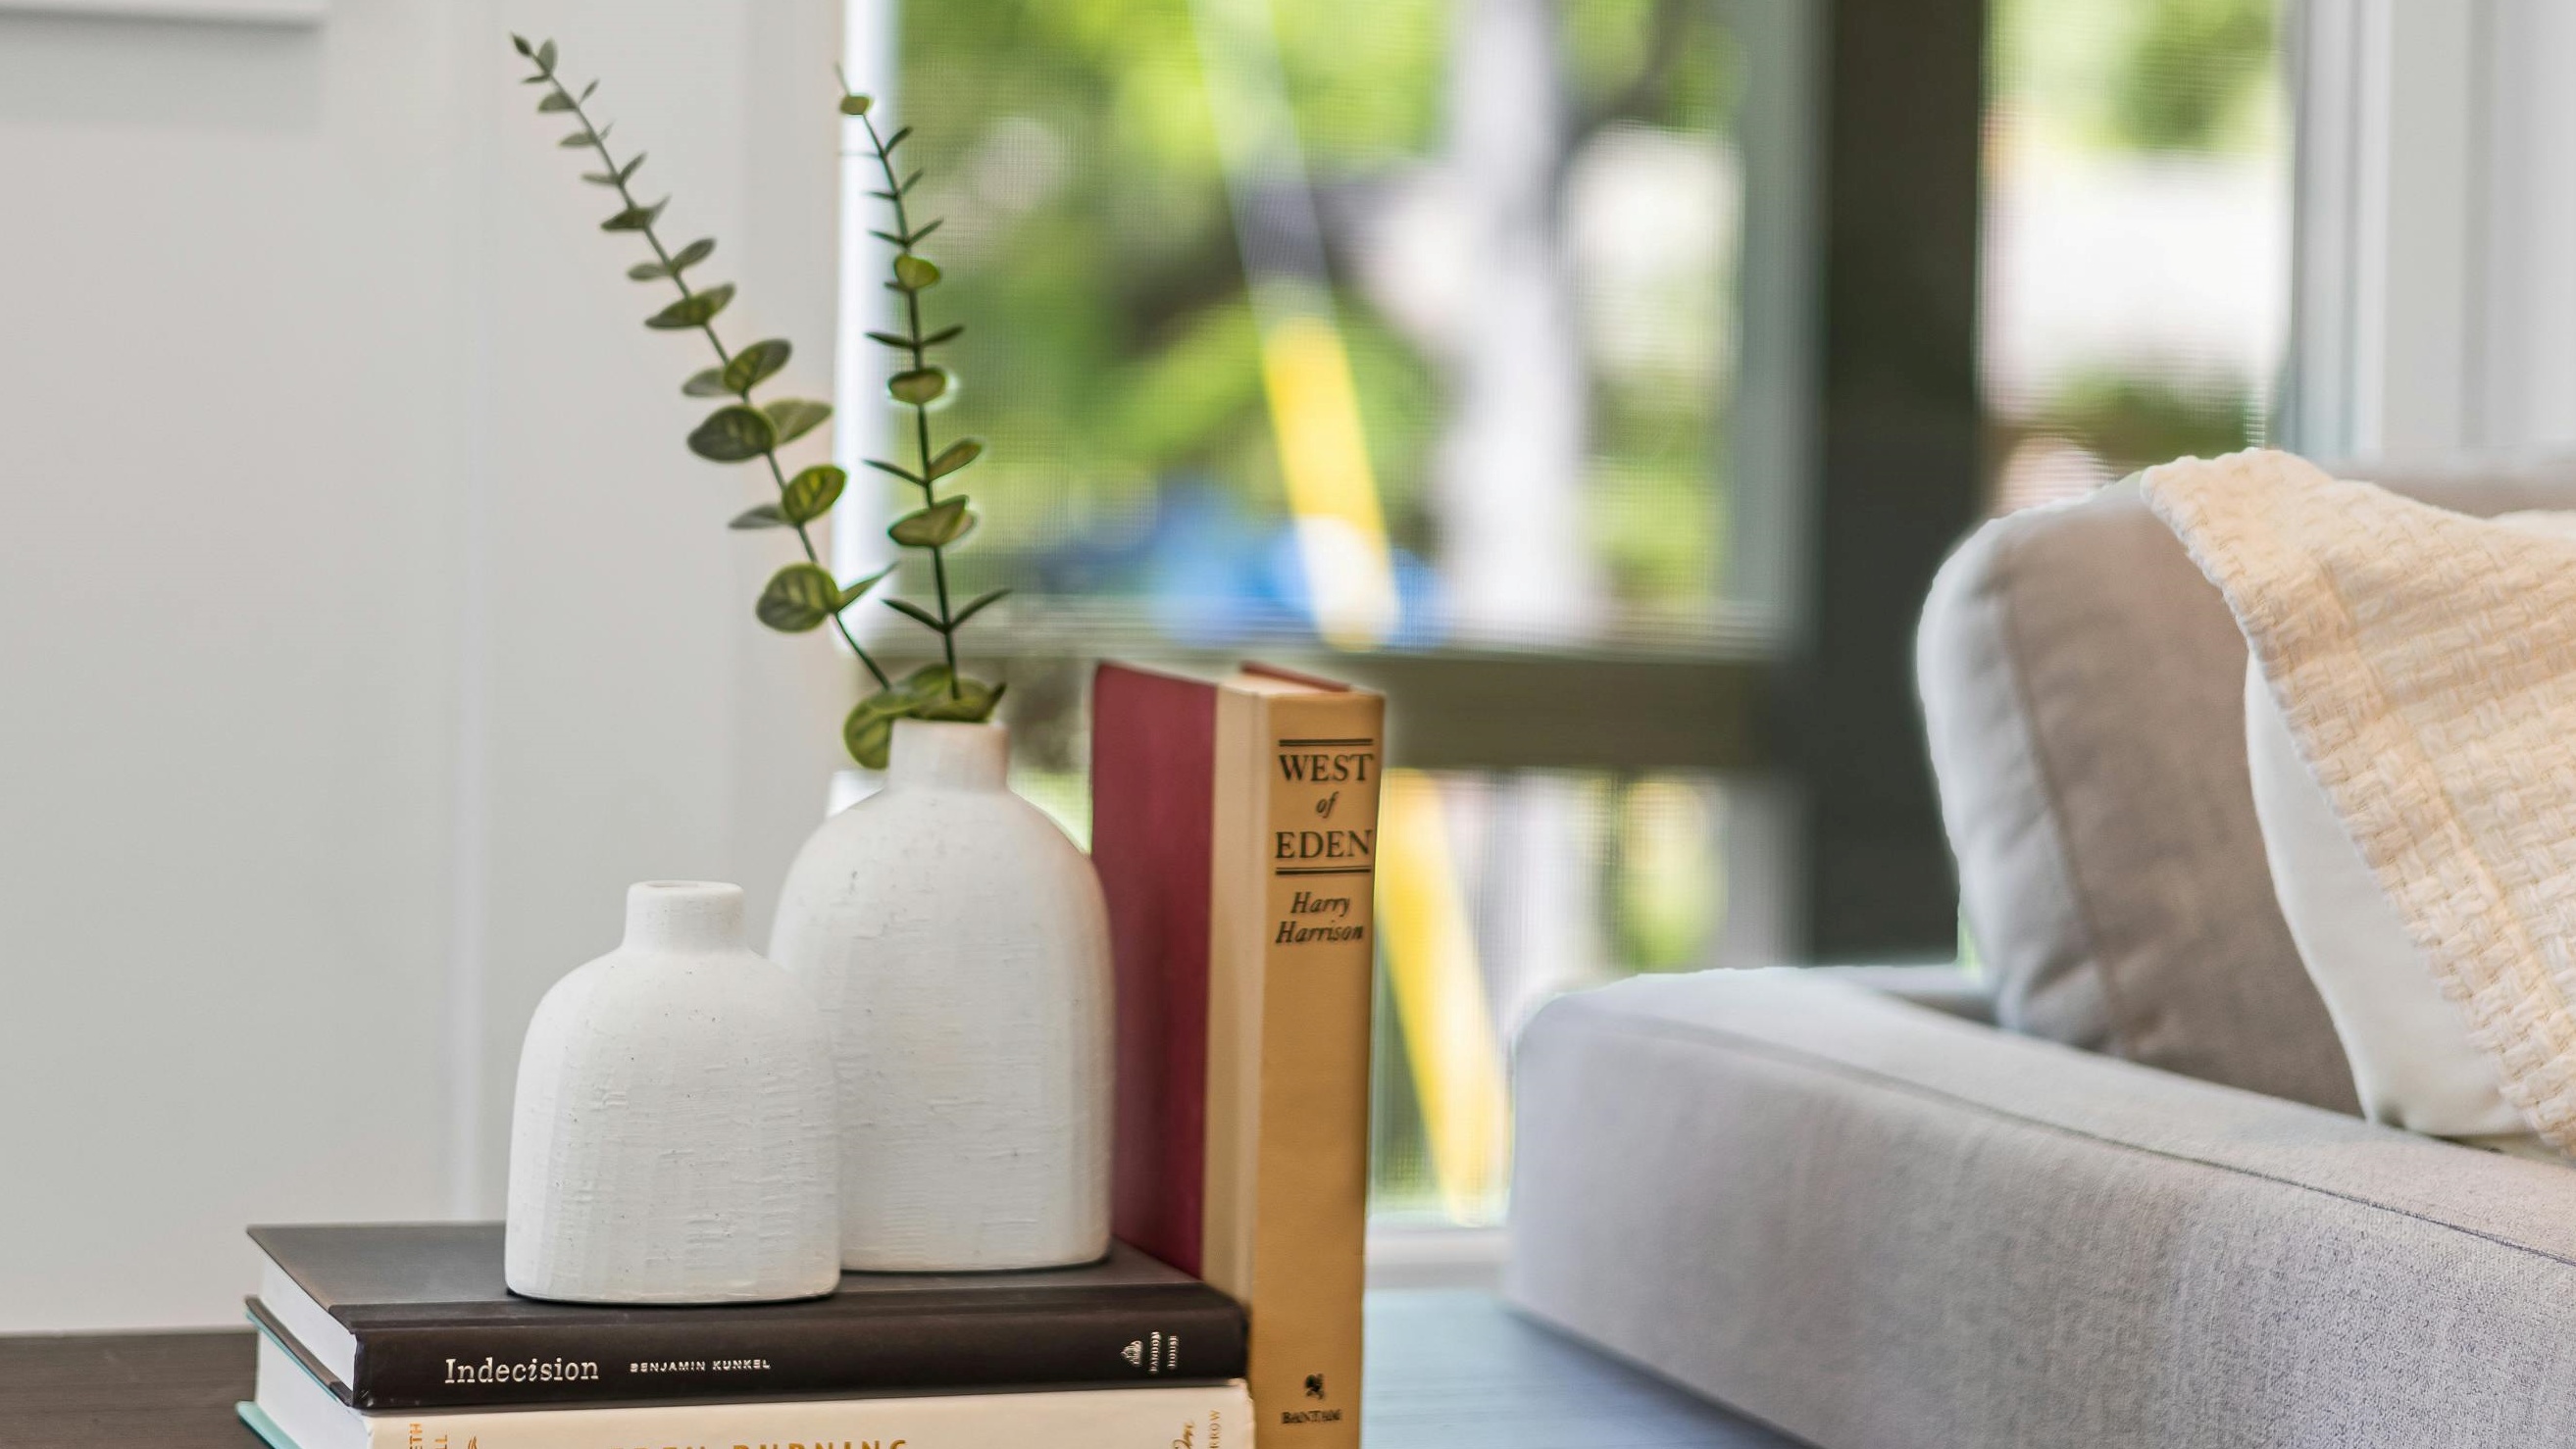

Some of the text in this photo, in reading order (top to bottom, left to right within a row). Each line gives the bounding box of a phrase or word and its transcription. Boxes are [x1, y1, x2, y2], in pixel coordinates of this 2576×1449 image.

[1278, 753, 1374, 782] WEST
[1316, 791, 1339, 819] of
[1275, 829, 1372, 859] EDEN
[1290, 891, 1350, 918] Harry
[1275, 920, 1363, 944] Harrison
[444, 1356, 599, 1384] Indecision
[630, 1359, 771, 1374] BENJAMIN KUNKEL
